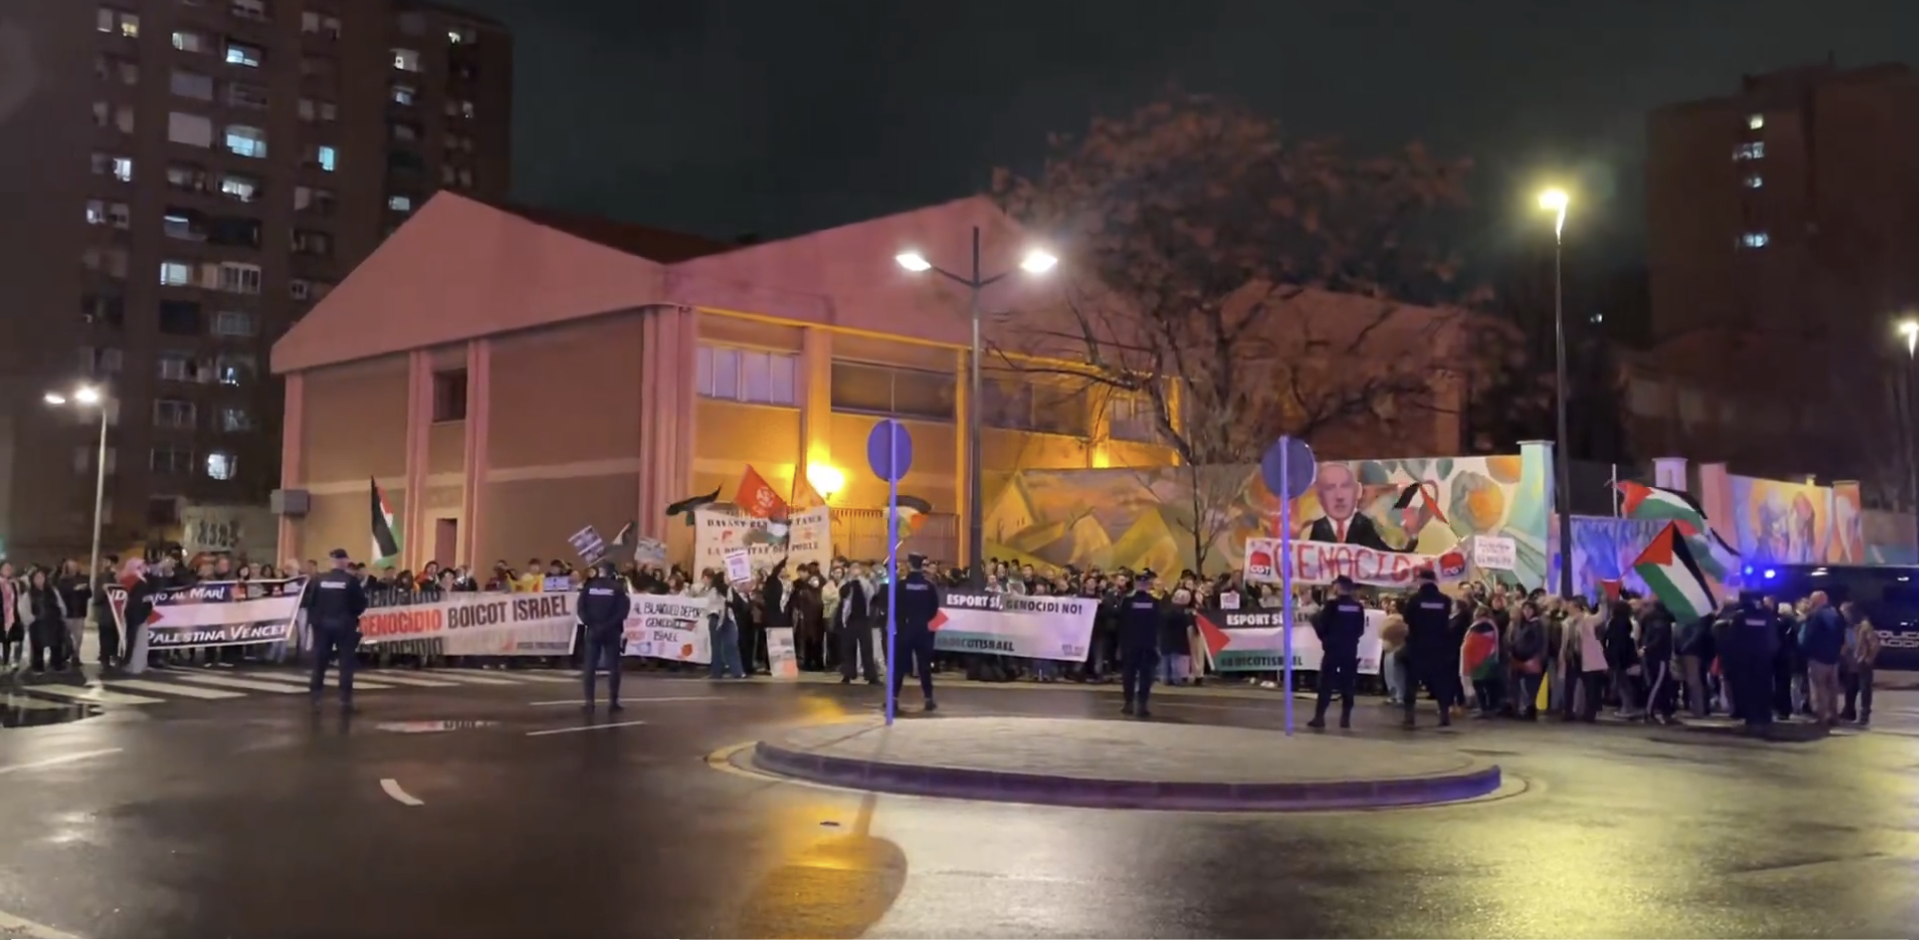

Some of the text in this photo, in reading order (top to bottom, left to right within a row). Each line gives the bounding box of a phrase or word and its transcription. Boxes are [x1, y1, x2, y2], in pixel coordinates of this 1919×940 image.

[1250, 565, 1271, 576] CGT
[448, 601, 507, 629] BOICOT
[512, 594, 570, 622] ISRAEL
[946, 594, 988, 606] ESPORT
[1005, 600, 1059, 613] GENOCIDI
[1062, 603, 1083, 615] NO!
[1226, 613, 1270, 626] ESPORT
[149, 627, 226, 643] PALESTINA
